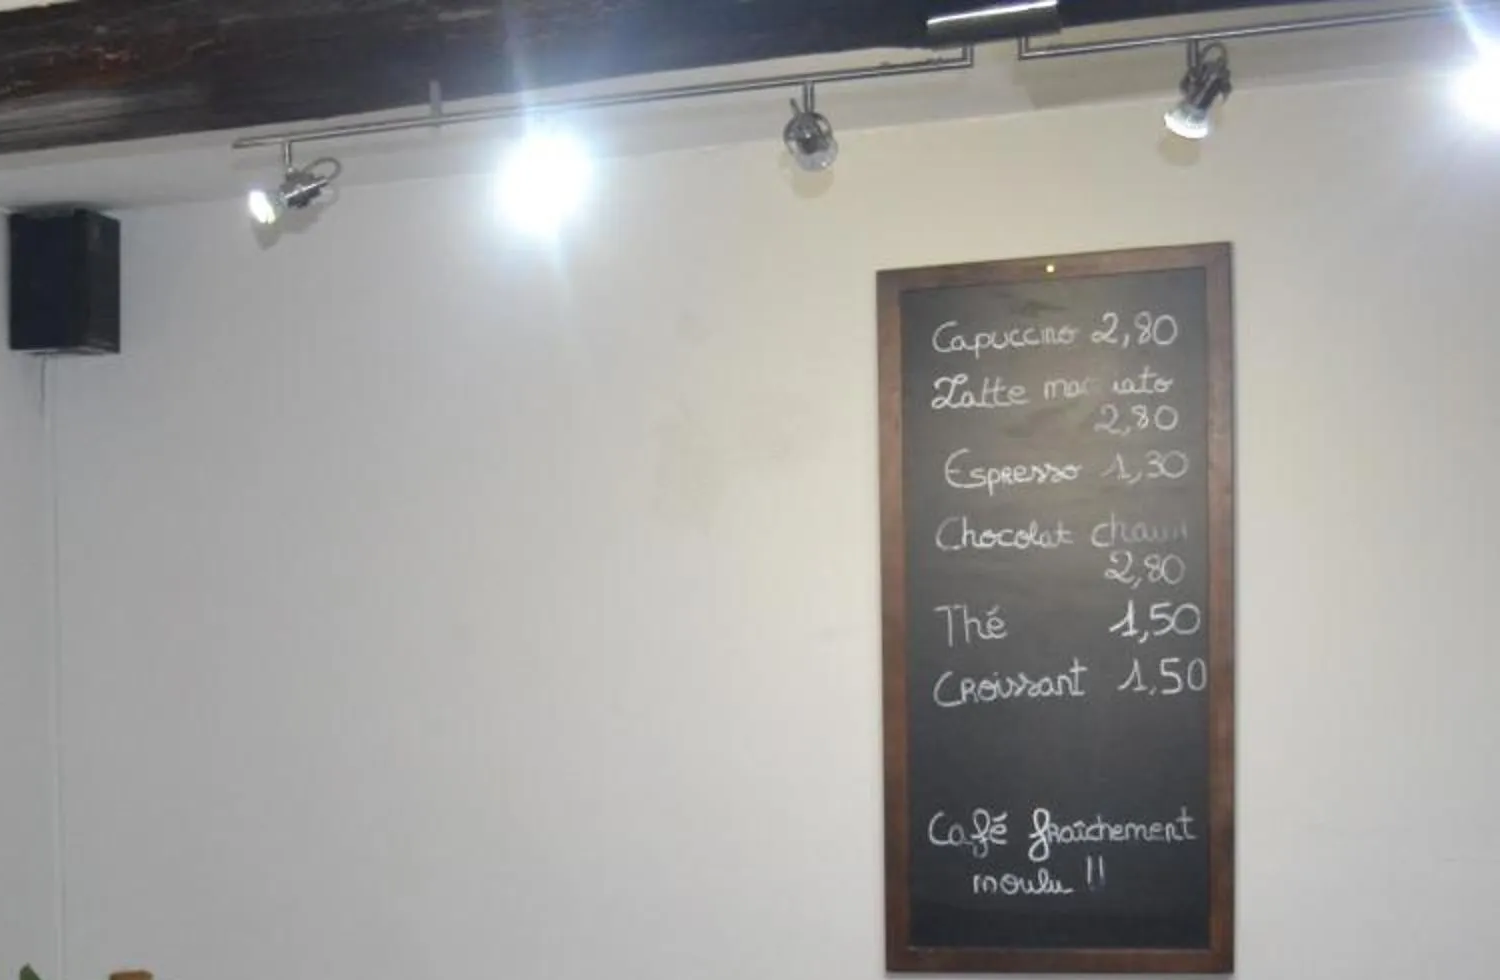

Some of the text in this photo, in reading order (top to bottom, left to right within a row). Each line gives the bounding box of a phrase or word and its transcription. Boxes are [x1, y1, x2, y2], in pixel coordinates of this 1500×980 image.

[931, 311, 1179, 360] Capuccino 2,80
[931, 373, 1032, 410] Latte
[1094, 404, 1180, 436] 2,80
[944, 447, 1189, 497] Espresso 1,30
[934, 516, 1075, 552] Chocolat
[1104, 549, 1186, 590] 2,80
[933, 599, 1202, 647] Thé 1,50
[933, 657, 1088, 708] Croissant
[928, 804, 1198, 863] Café fraîchement
[972, 866, 1075, 896] moulu
